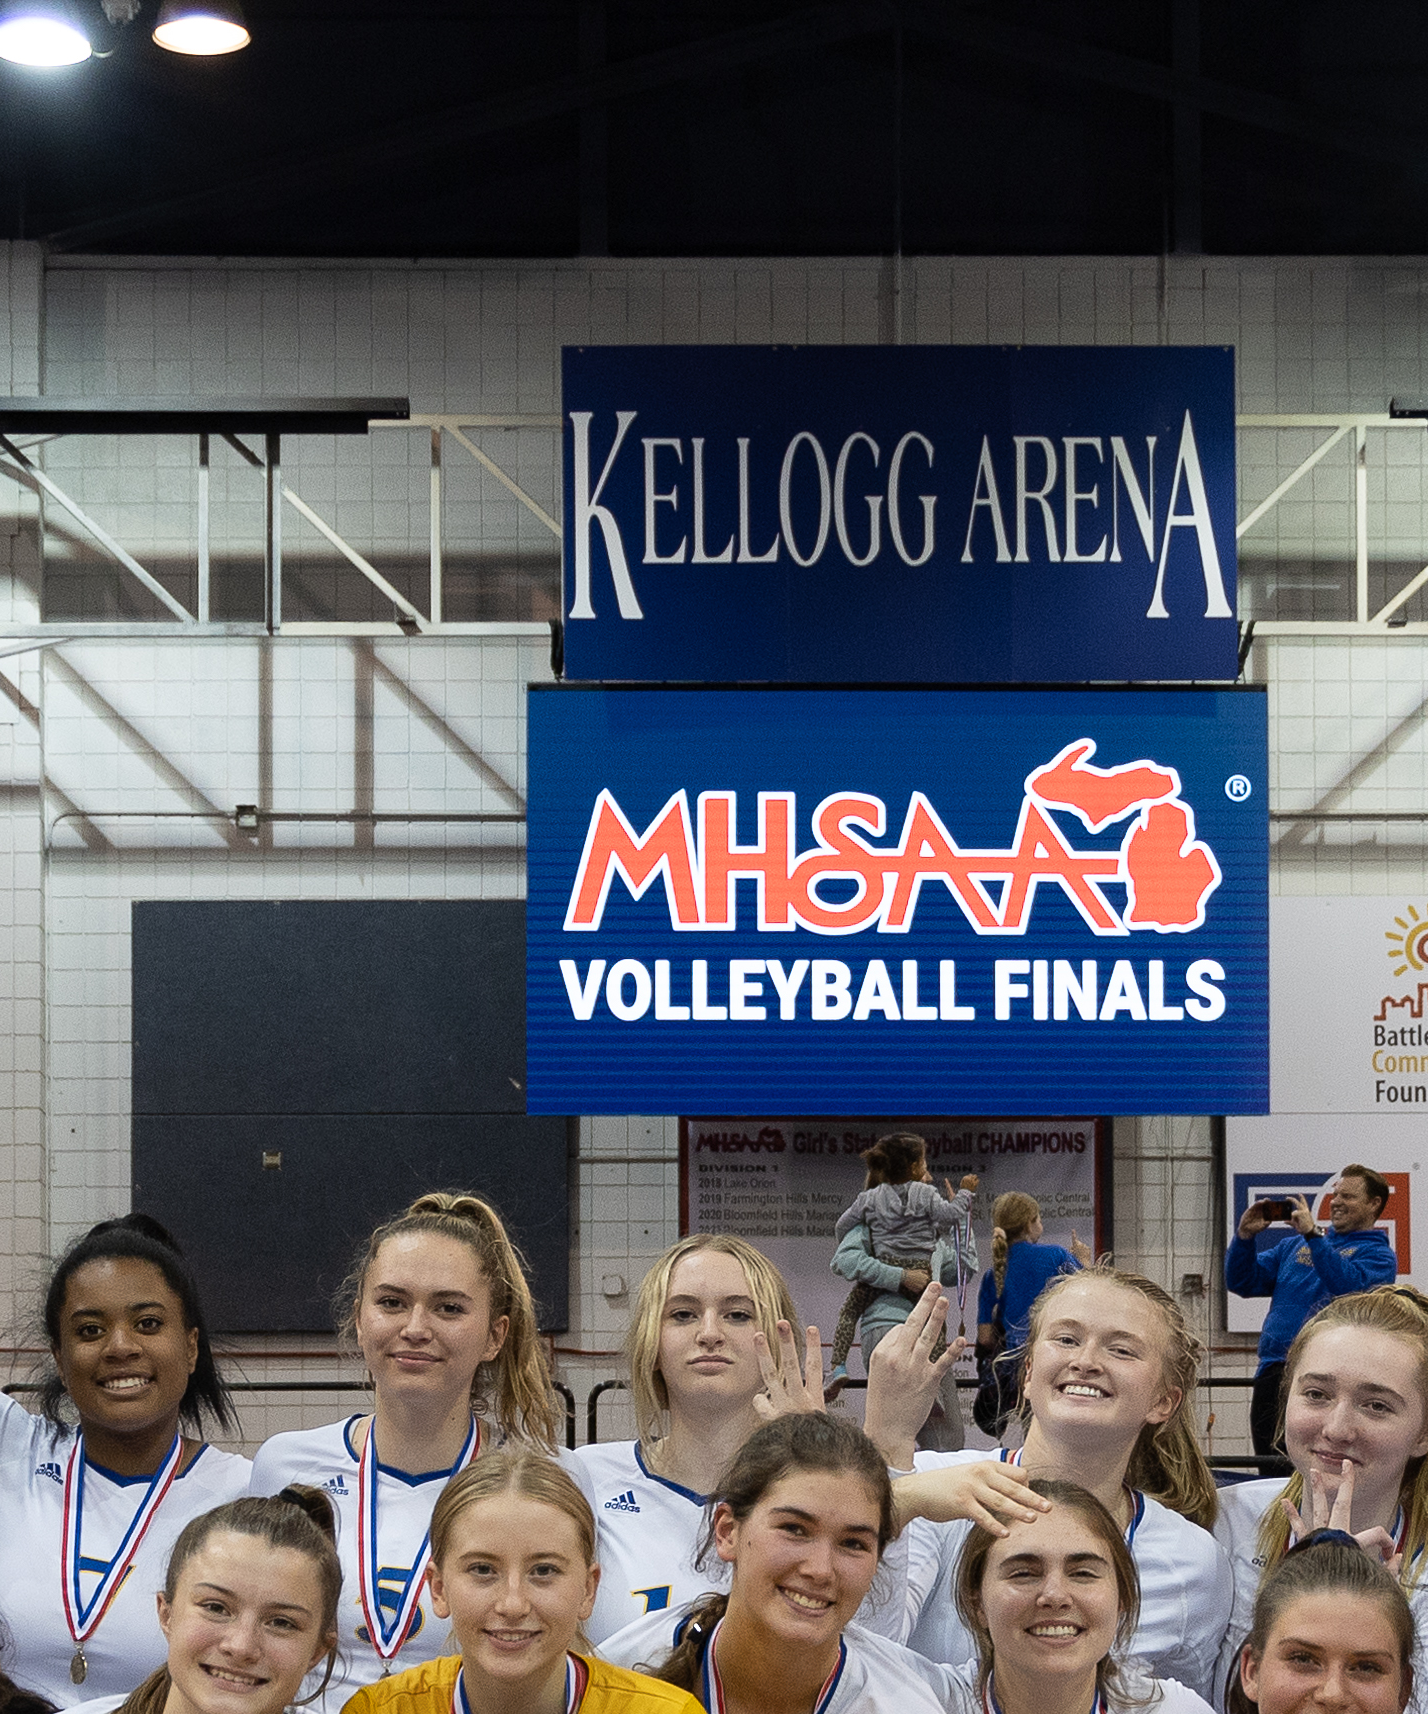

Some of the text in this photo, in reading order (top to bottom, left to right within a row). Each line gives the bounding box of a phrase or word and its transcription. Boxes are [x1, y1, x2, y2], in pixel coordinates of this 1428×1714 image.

[569, 408, 1233, 620] KELLOGG ARENA
[563, 788, 1133, 936] MHSAA
[559, 959, 1227, 1021] VOLLEYBALL FINALS
[793, 1132, 838, 1154] Girl's
[842, 1132, 877, 1154] Stat
[977, 1131, 1086, 1154] CHAMPIONS
[699, 1164, 767, 1173] DIVISION
[604, 1501, 641, 1514] adidas
